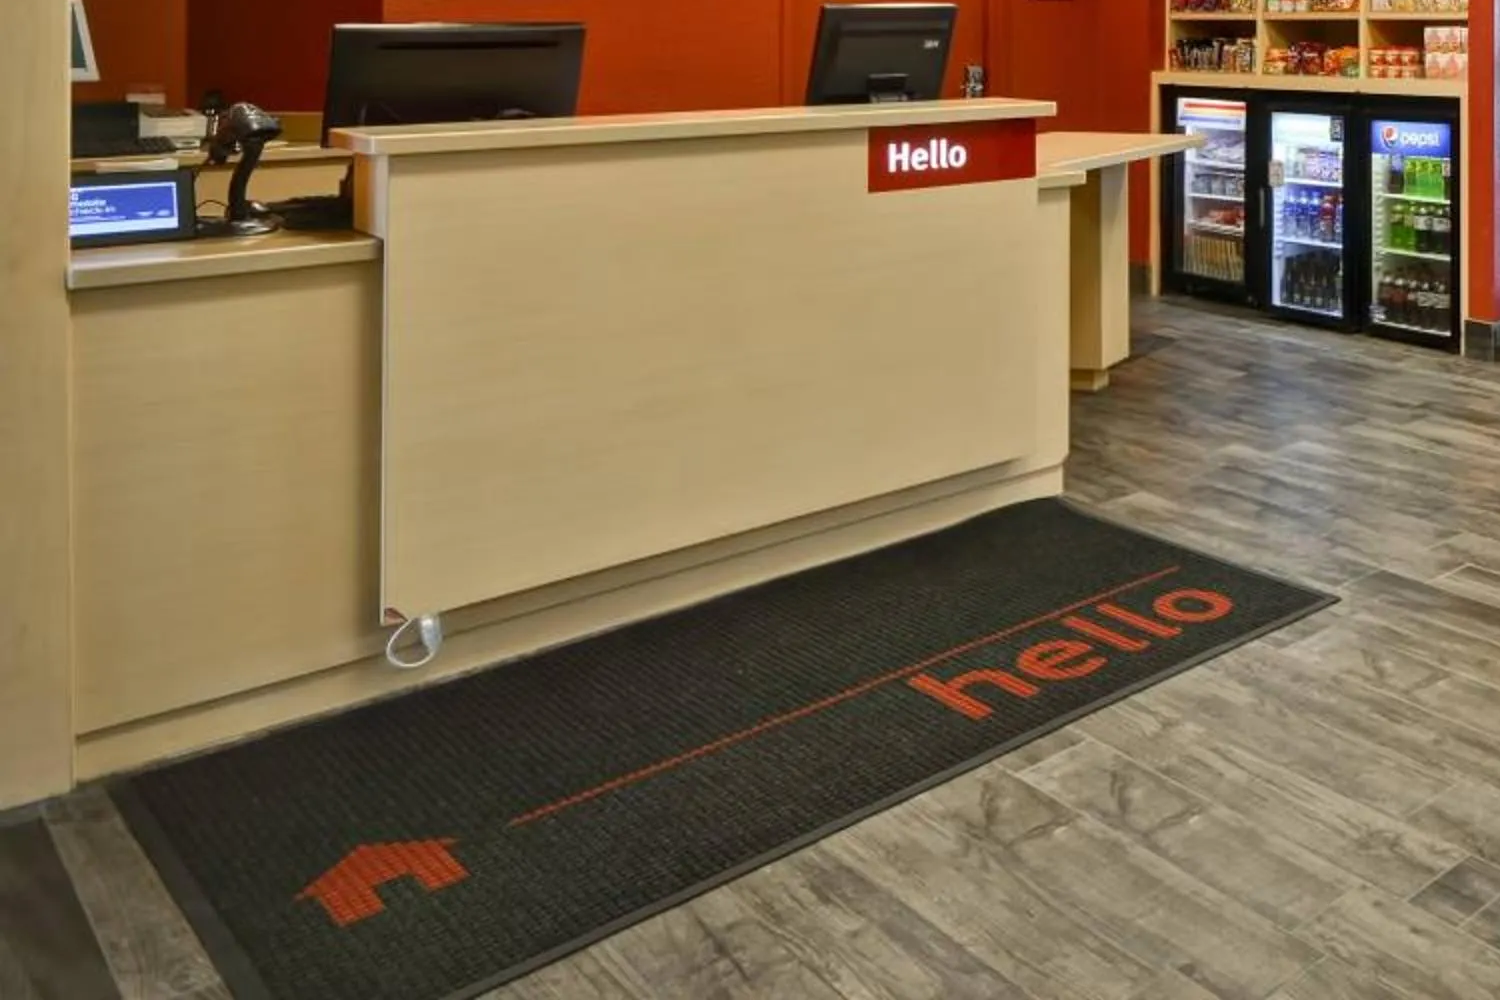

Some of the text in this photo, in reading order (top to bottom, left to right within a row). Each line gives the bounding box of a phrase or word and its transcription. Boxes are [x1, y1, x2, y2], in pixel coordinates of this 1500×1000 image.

[887, 138, 967, 173] Hello
[1401, 131, 1440, 149] pepsi
[907, 587, 1234, 721] hello
